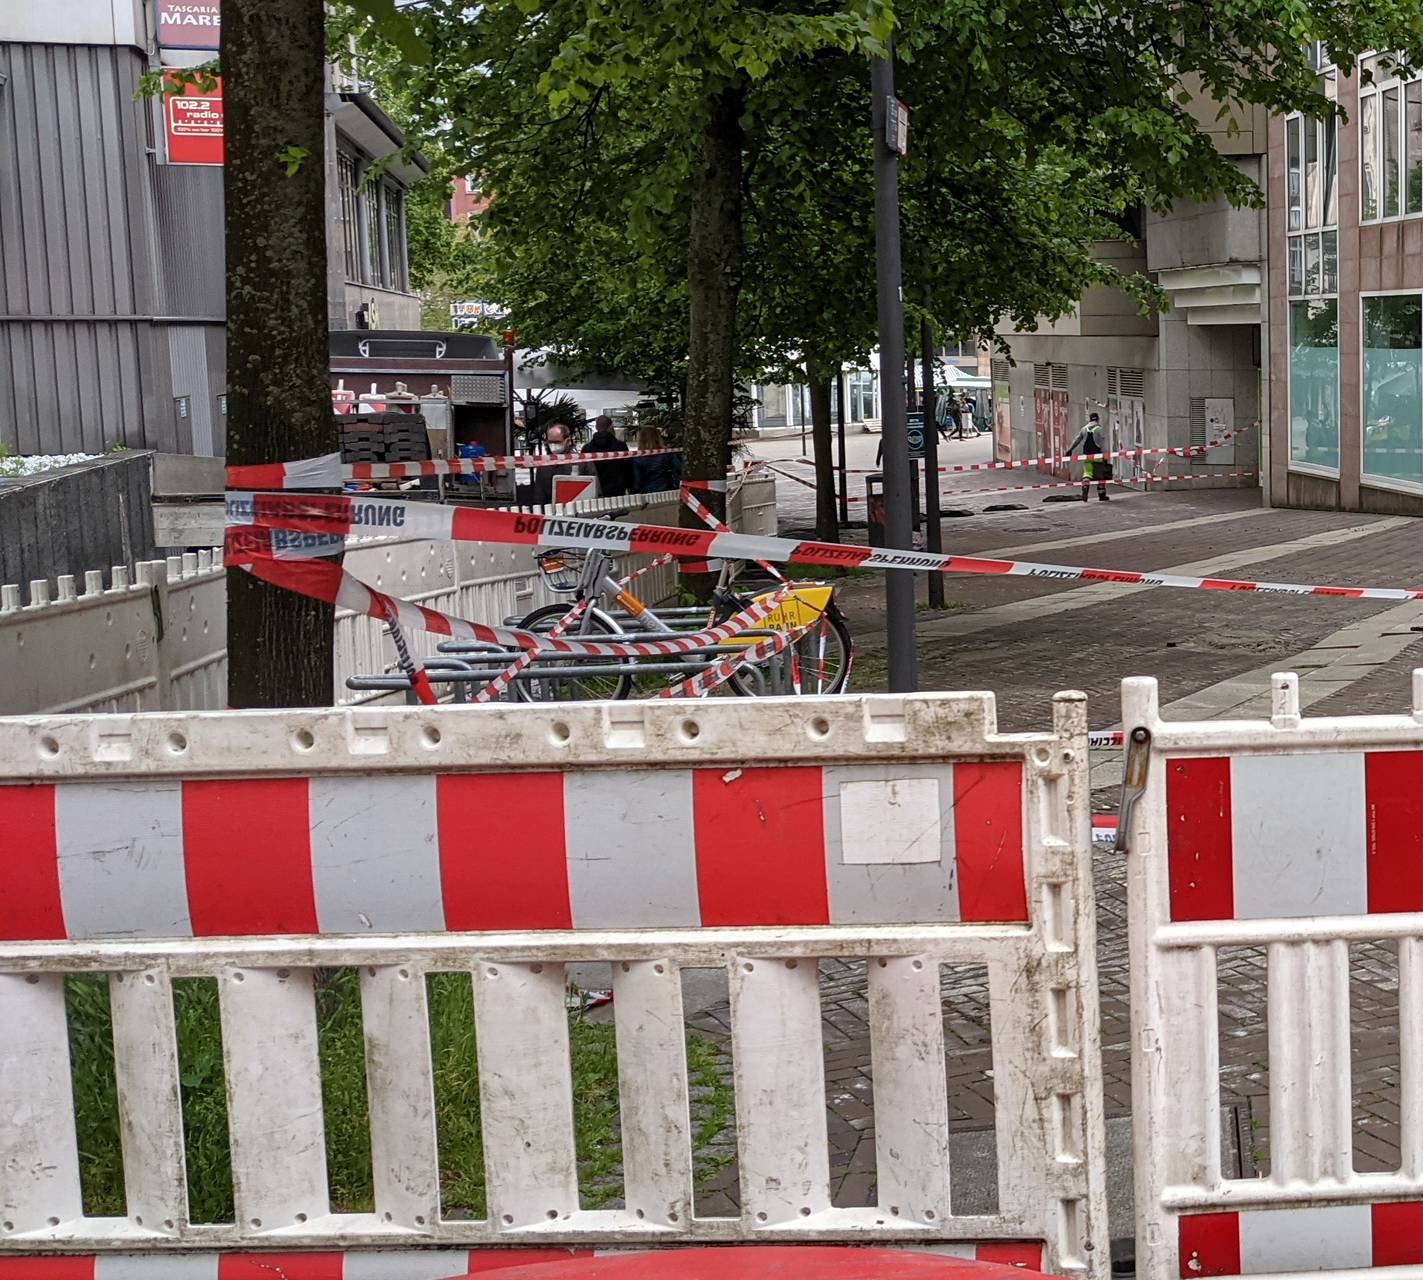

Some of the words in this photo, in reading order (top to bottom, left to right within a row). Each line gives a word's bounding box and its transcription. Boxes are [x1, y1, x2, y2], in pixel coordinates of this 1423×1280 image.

[168, 5, 218, 13] TASCARIA
[161, 12, 221, 26] MARE
[175, 101, 210, 110] 102.2
[186, 111, 220, 119] radio
